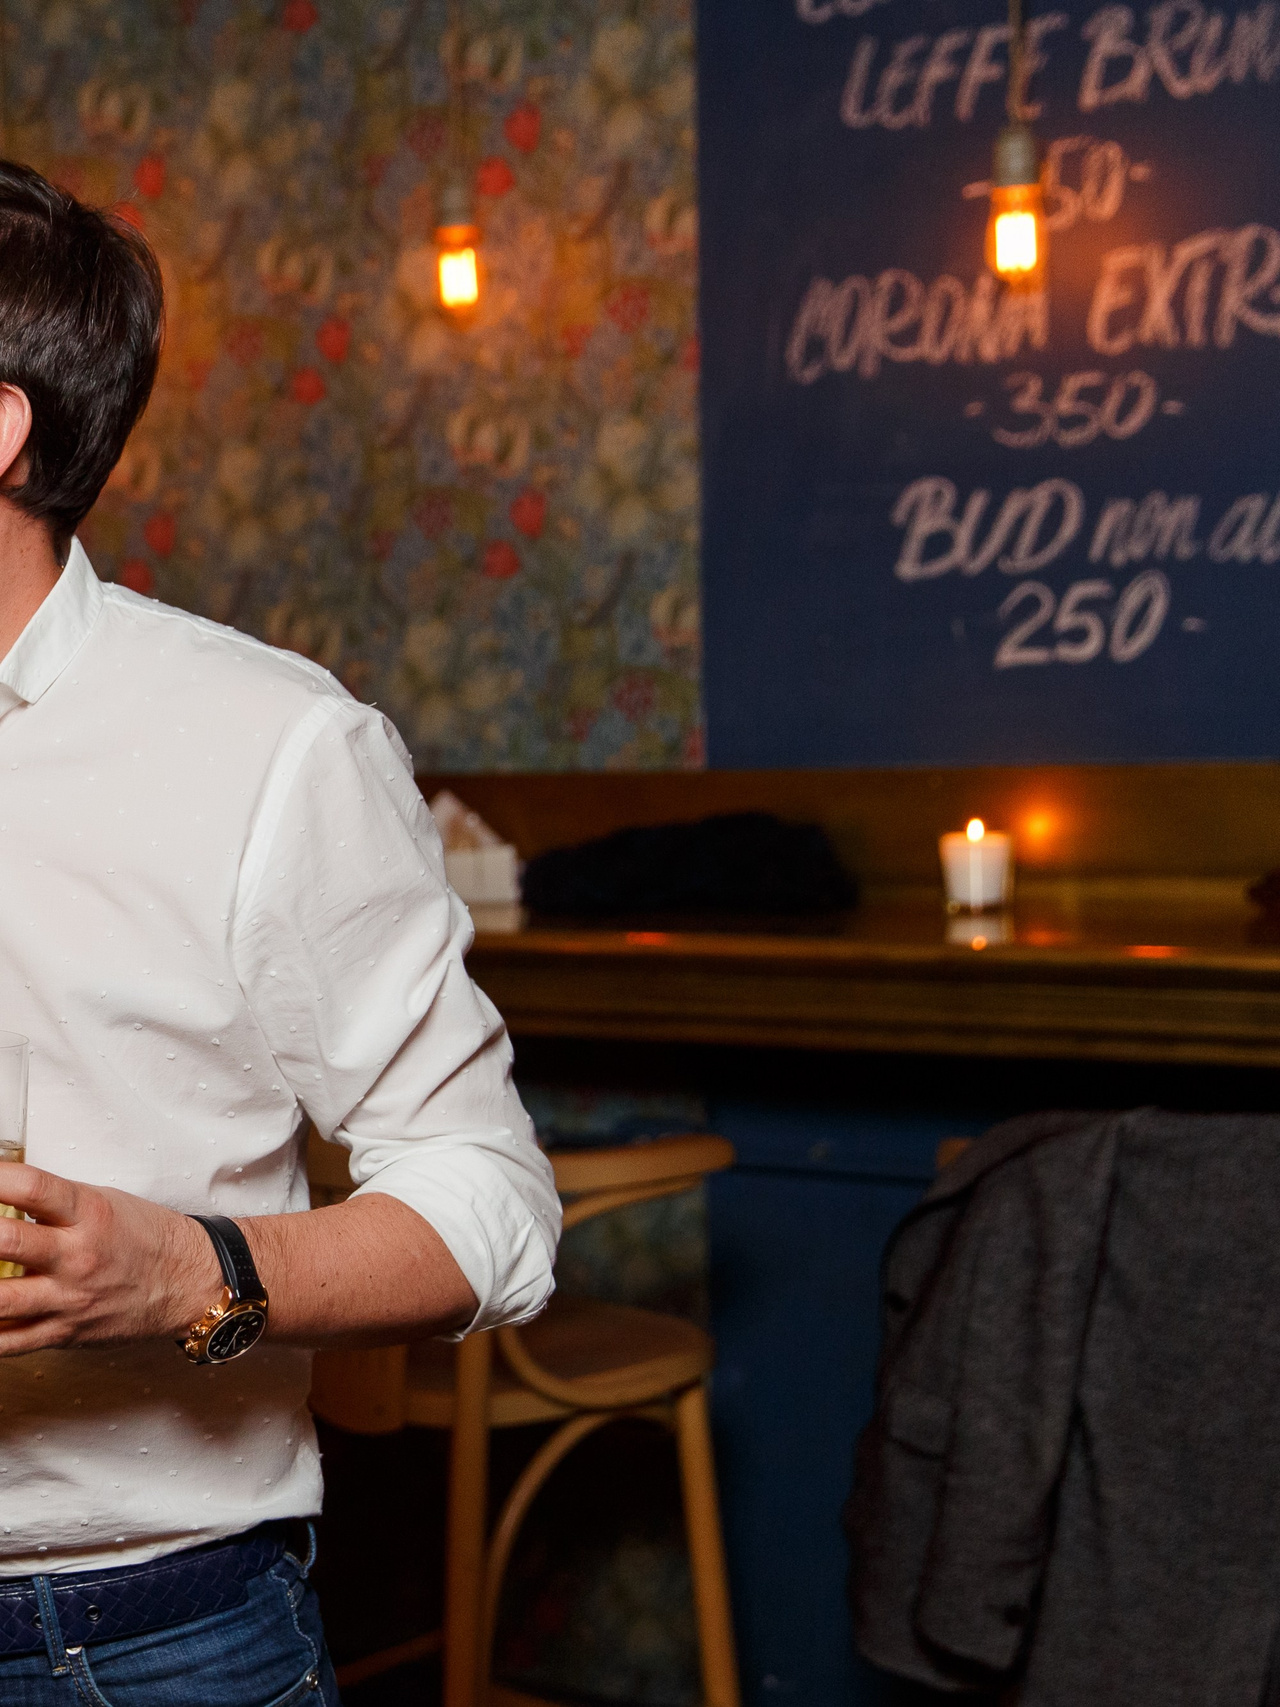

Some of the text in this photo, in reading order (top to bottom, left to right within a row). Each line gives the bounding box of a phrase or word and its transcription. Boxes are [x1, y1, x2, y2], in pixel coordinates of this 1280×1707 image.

[839, 14, 1069, 129] LEFFE
[890, 475, 1085, 583] BUD
[1087, 488, 1202, 568] non
